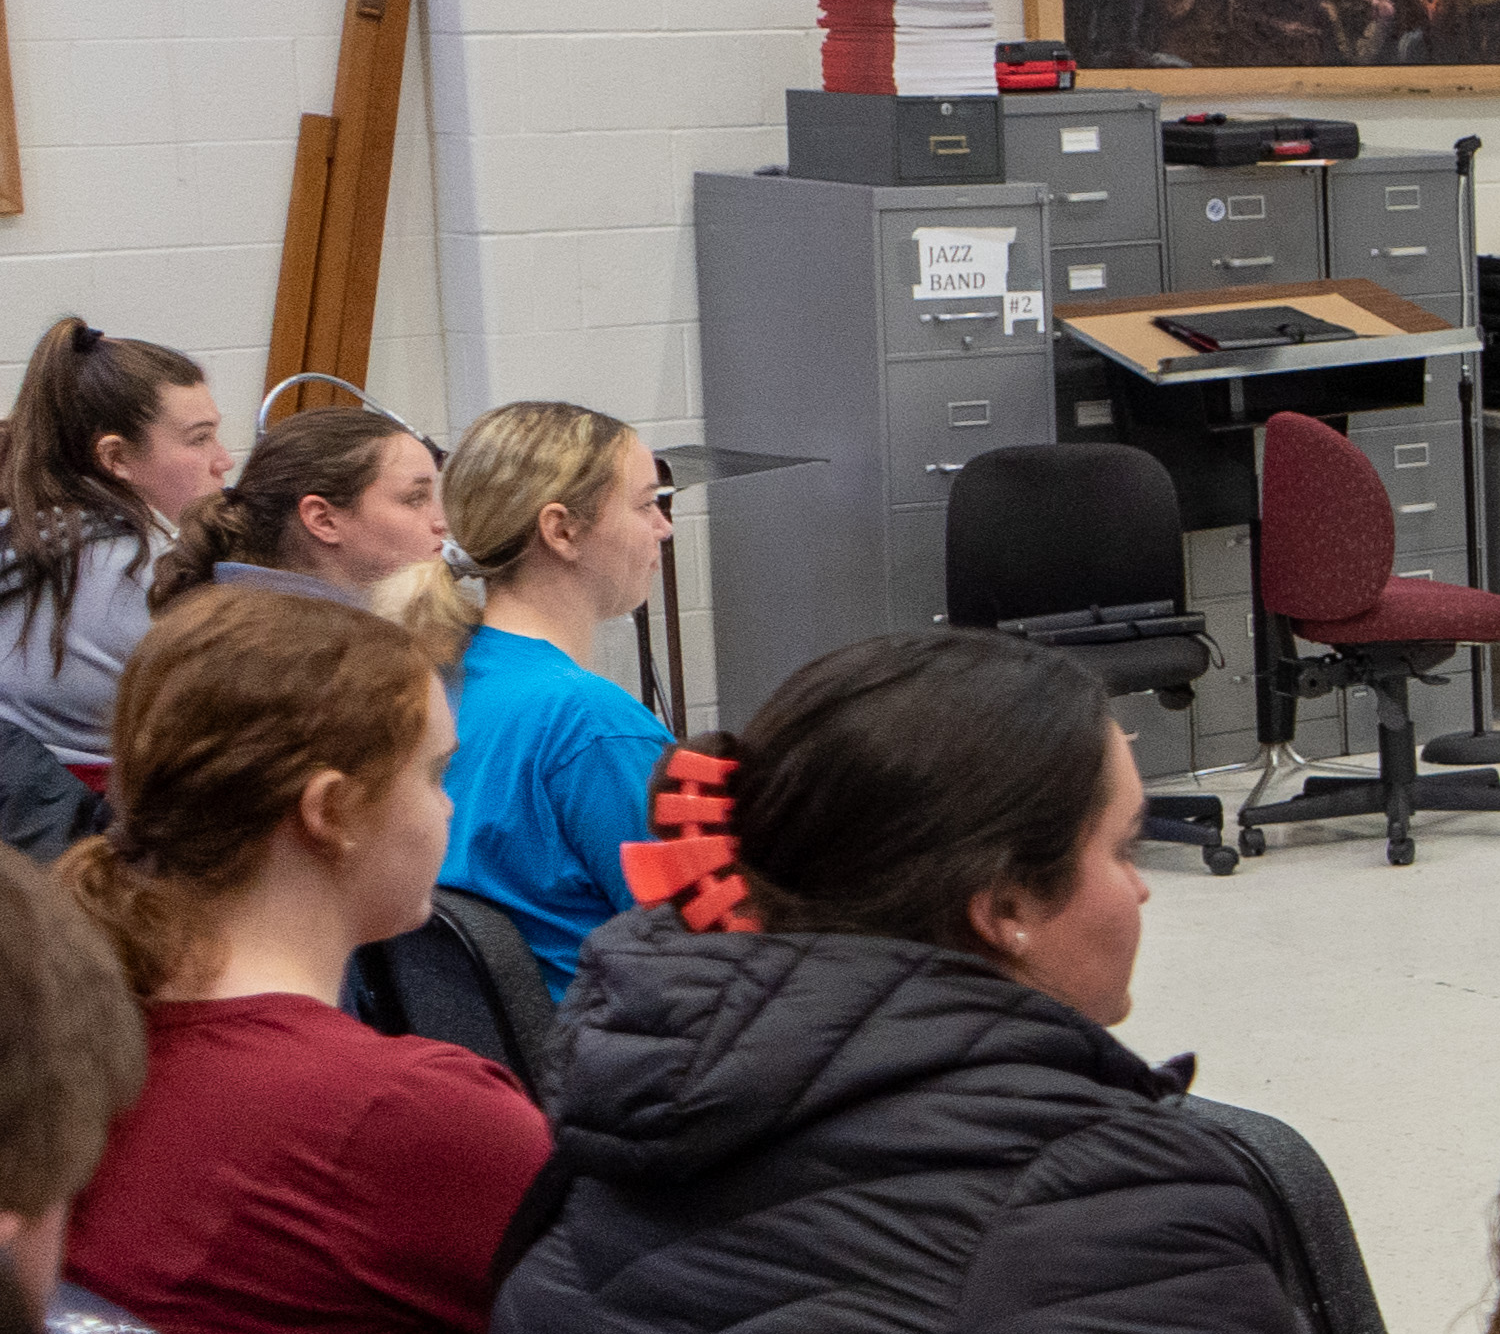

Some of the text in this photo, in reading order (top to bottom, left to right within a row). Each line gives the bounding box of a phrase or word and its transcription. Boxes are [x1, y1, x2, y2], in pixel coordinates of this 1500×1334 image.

[928, 244, 974, 267] JAZZ
[930, 271, 986, 291] BAND
[1009, 295, 1033, 314] #2
